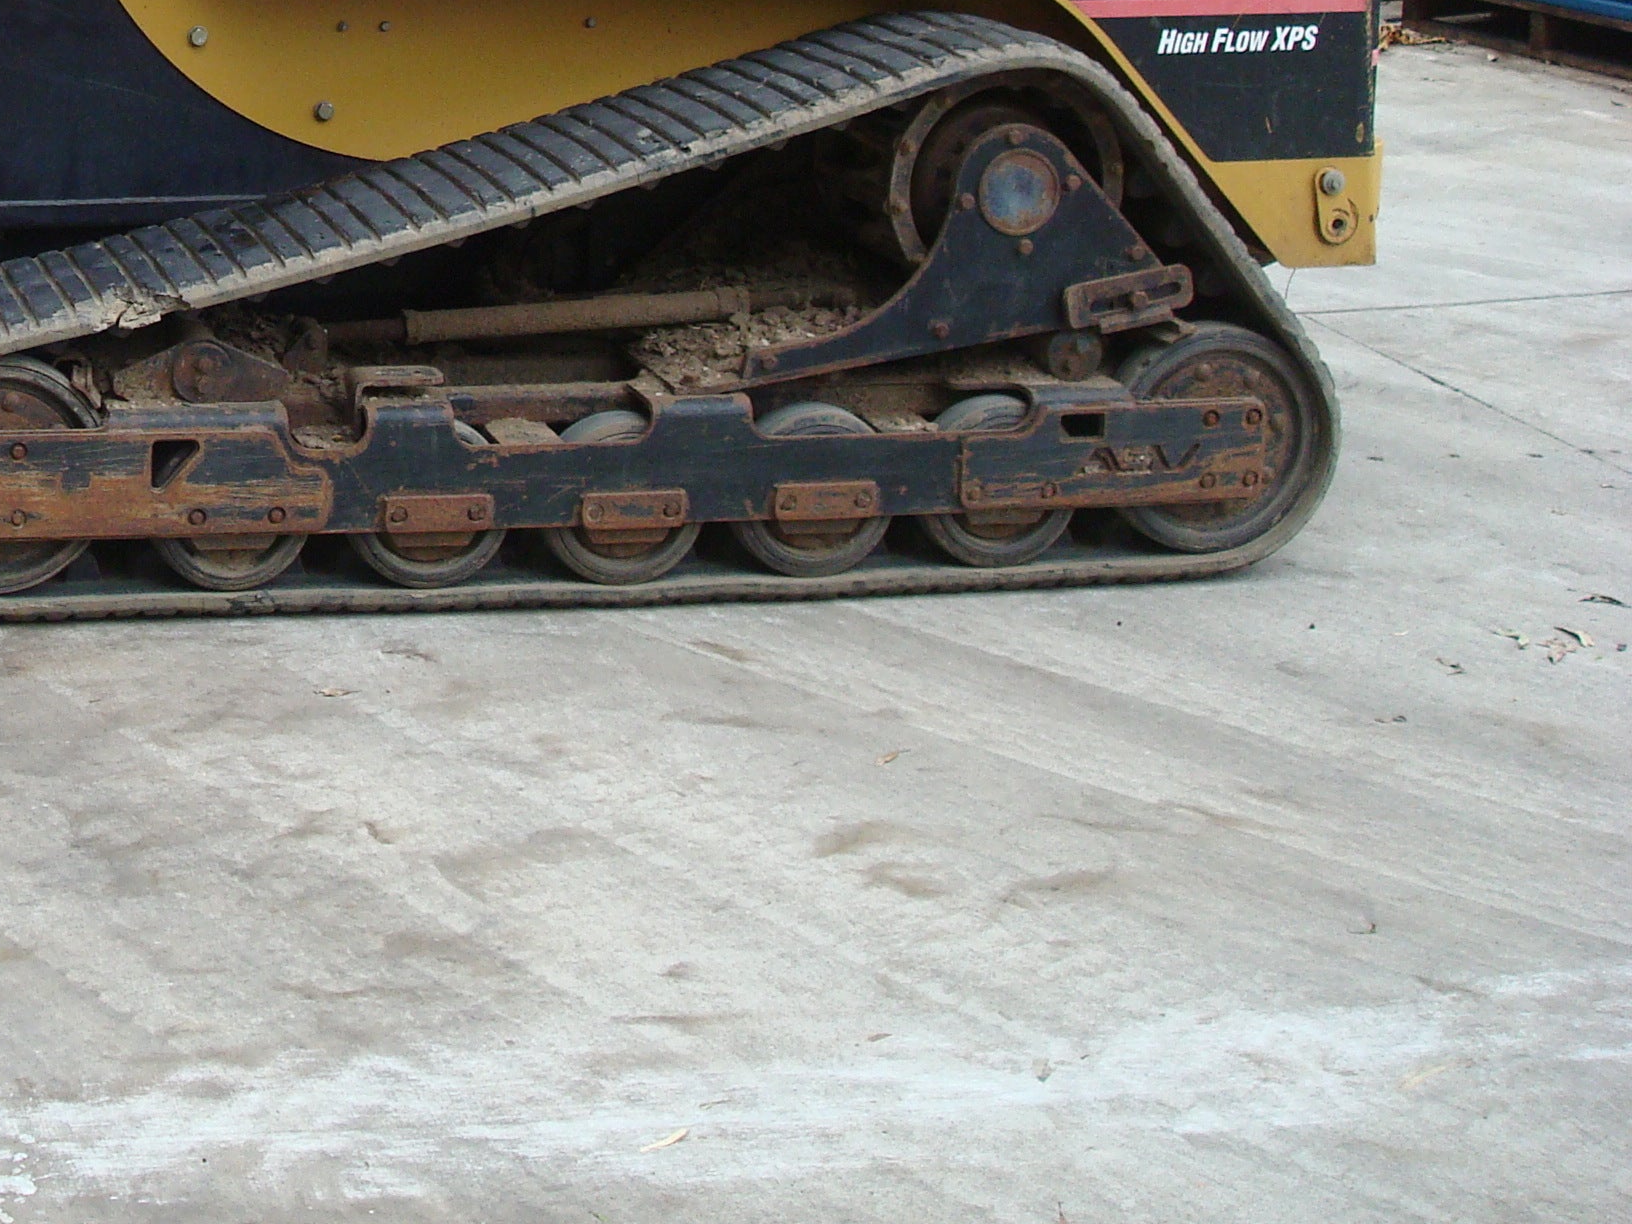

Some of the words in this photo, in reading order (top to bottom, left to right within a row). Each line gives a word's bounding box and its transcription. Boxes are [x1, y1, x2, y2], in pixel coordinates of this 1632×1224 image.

[1158, 28, 1207, 55] HIGH
[1211, 28, 1269, 53] FLOW
[1271, 25, 1319, 51] XPS
